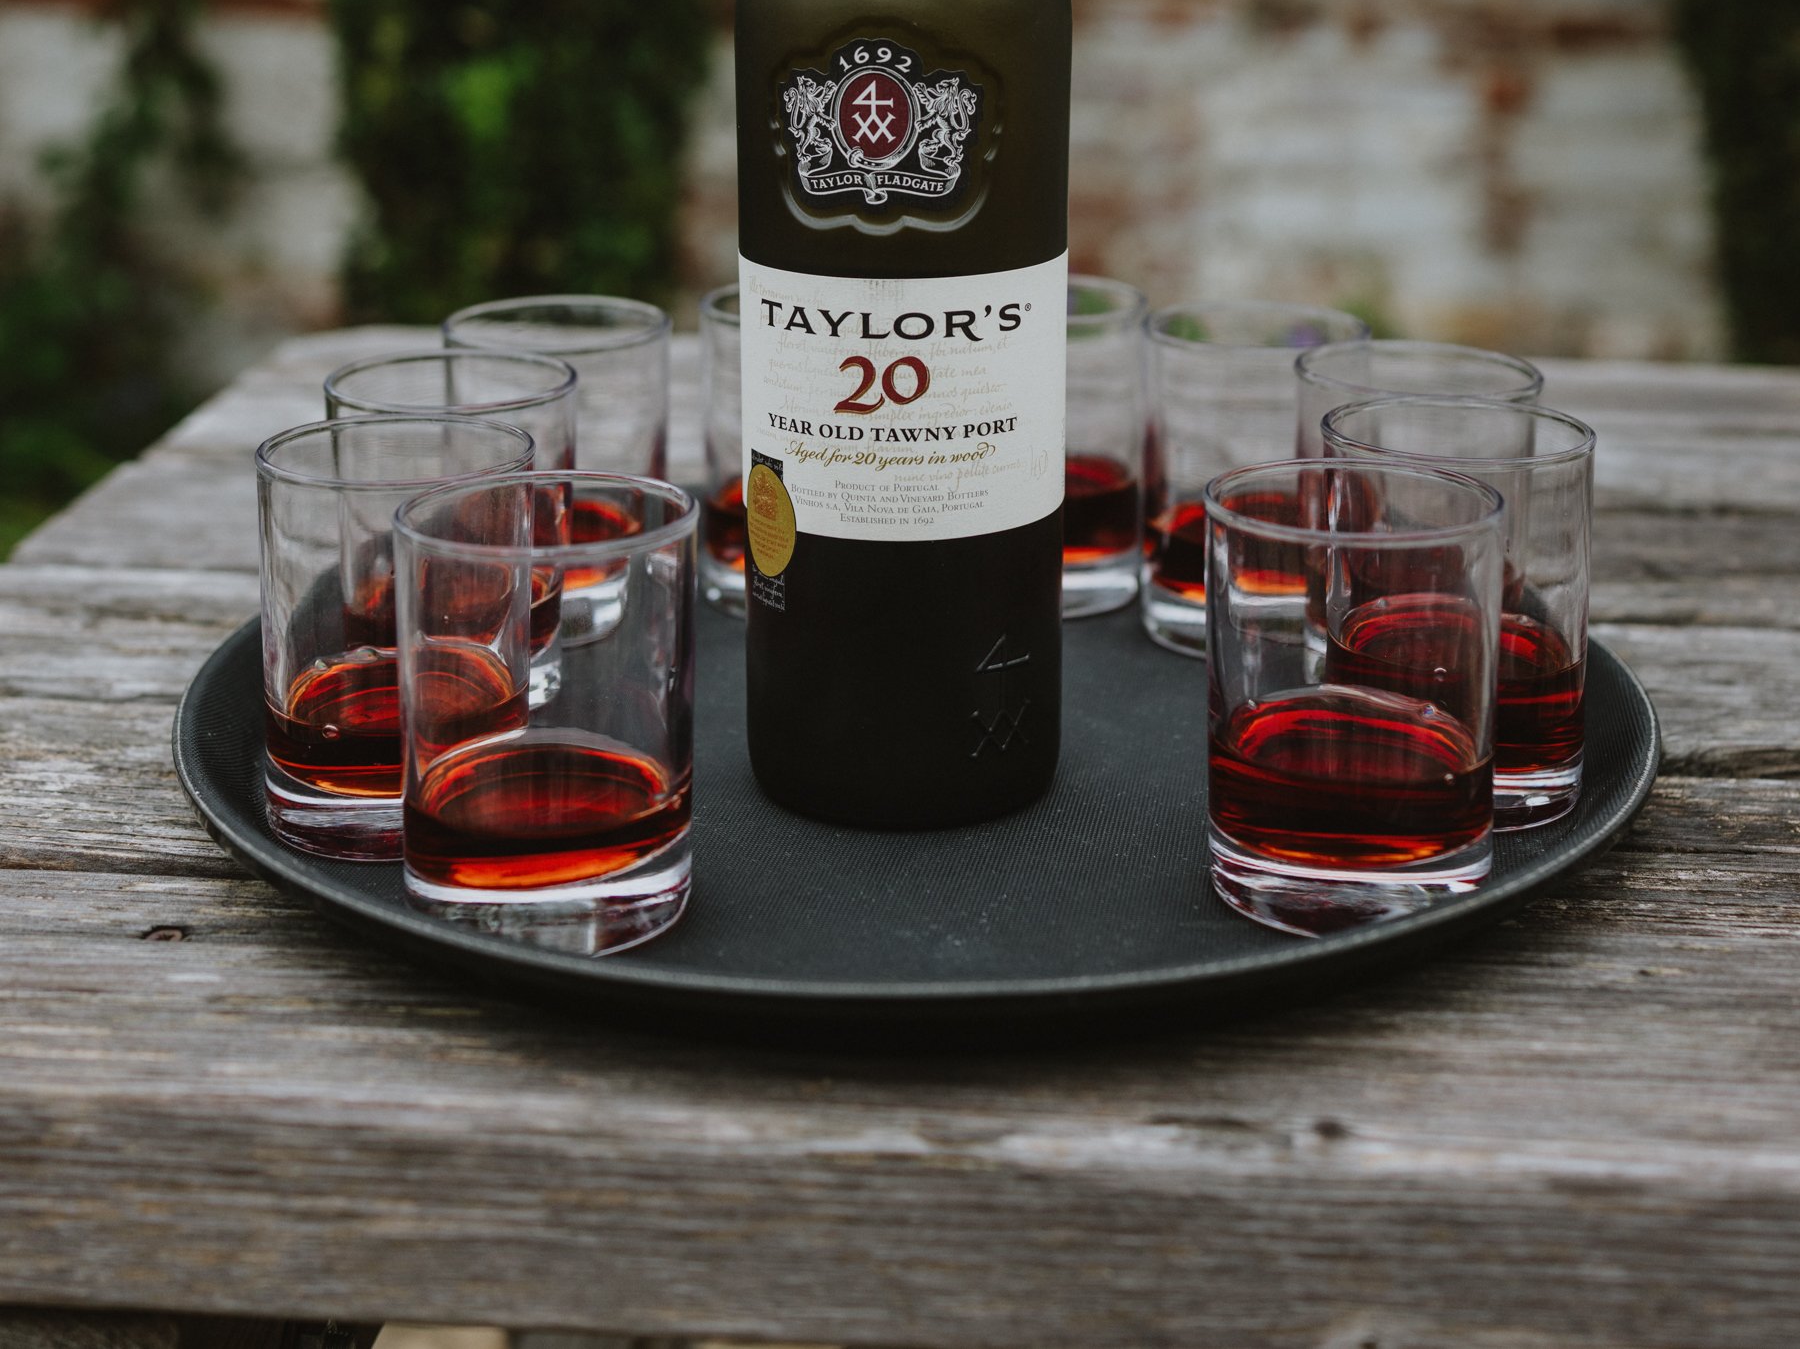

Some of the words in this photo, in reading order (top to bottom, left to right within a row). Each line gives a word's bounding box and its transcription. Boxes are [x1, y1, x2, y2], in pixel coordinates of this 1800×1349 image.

[839, 45, 913, 73] 1692
[811, 173, 863, 189] TAYLOR
[877, 173, 945, 192] FLADGATE
[833, 355, 931, 415] 20
[768, 412, 813, 436] YEAR
[819, 424, 865, 441] OLD
[871, 425, 958, 442] TAWNY
[963, 416, 1018, 439] PORT
[785, 440, 828, 464] Aged
[827, 450, 854, 467] for
[852, 452, 877, 464] 20
[874, 453, 925, 471] years
[928, 450, 948, 464] in
[949, 441, 996, 462] wood
[791, 483, 825, 497] BOTTLED
[827, 490, 837, 499] BY
[840, 492, 877, 504] QUINTA
[880, 494, 898, 502] AND
[900, 491, 944, 502] VINEYARD
[947, 488, 989, 500] BOTTLERS
[835, 480, 873, 491] PRODUCT
[893, 483, 939, 492] PORTUGAL
[795, 494, 823, 508] VINHOS
[844, 503, 864, 513] VILA
[867, 504, 893, 514] NOVA
[941, 500, 984, 512] PORTUGAL
[840, 513, 896, 524] ESTABLISHED
[913, 516, 935, 524] 1692
